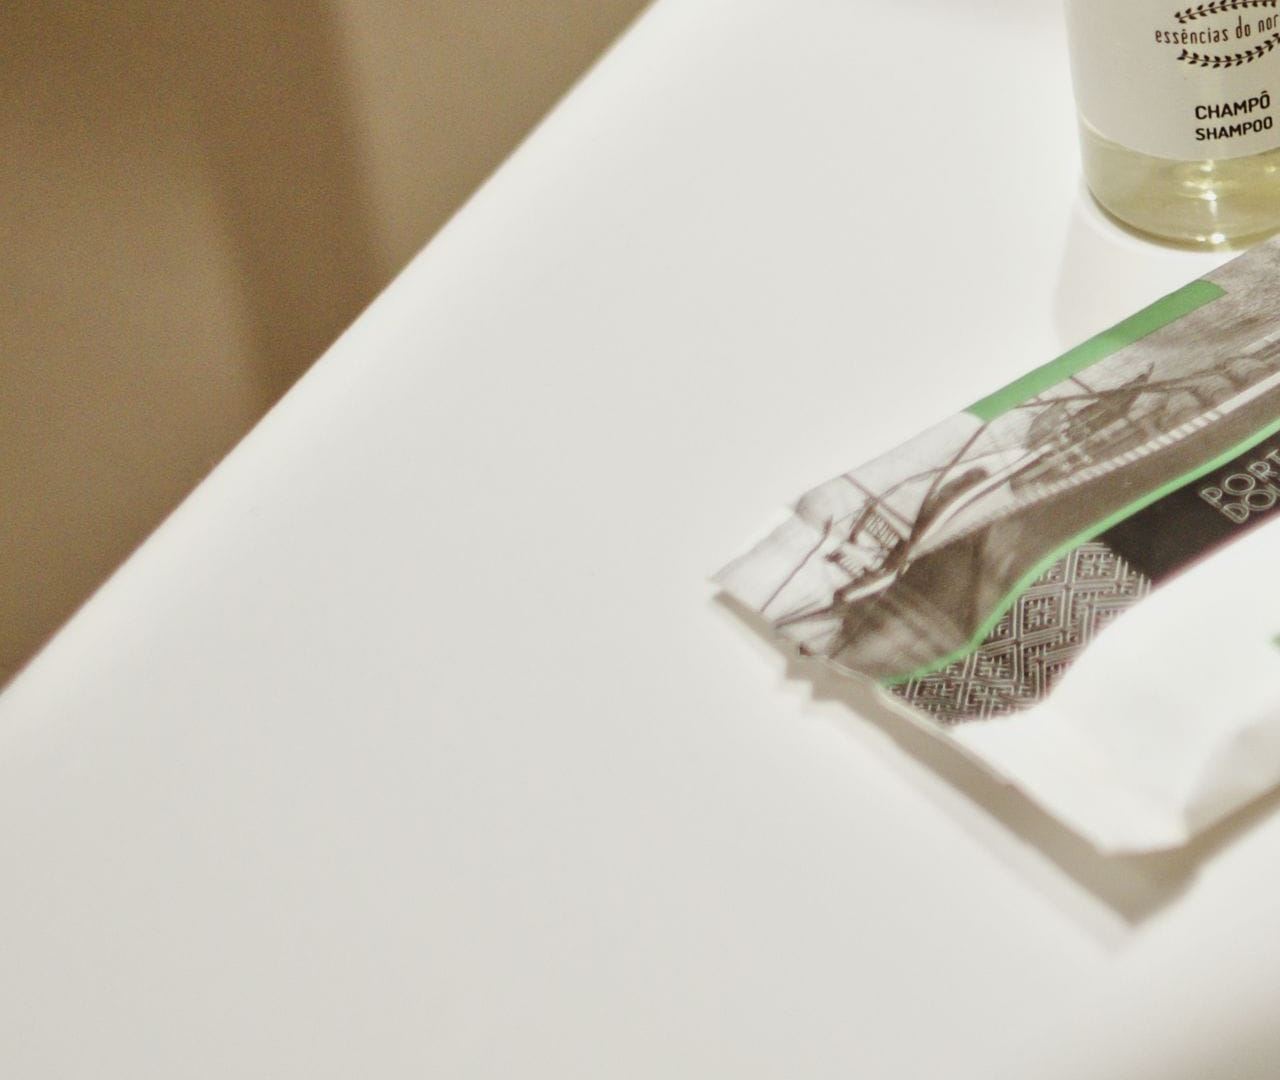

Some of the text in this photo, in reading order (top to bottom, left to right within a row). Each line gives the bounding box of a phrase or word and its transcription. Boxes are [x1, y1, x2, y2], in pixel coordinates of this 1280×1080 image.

[1155, 27, 1229, 45] essências
[1235, 16, 1251, 39] do
[1195, 91, 1270, 120] CHAMPÔ
[1195, 116, 1273, 141] SHAMPOO
